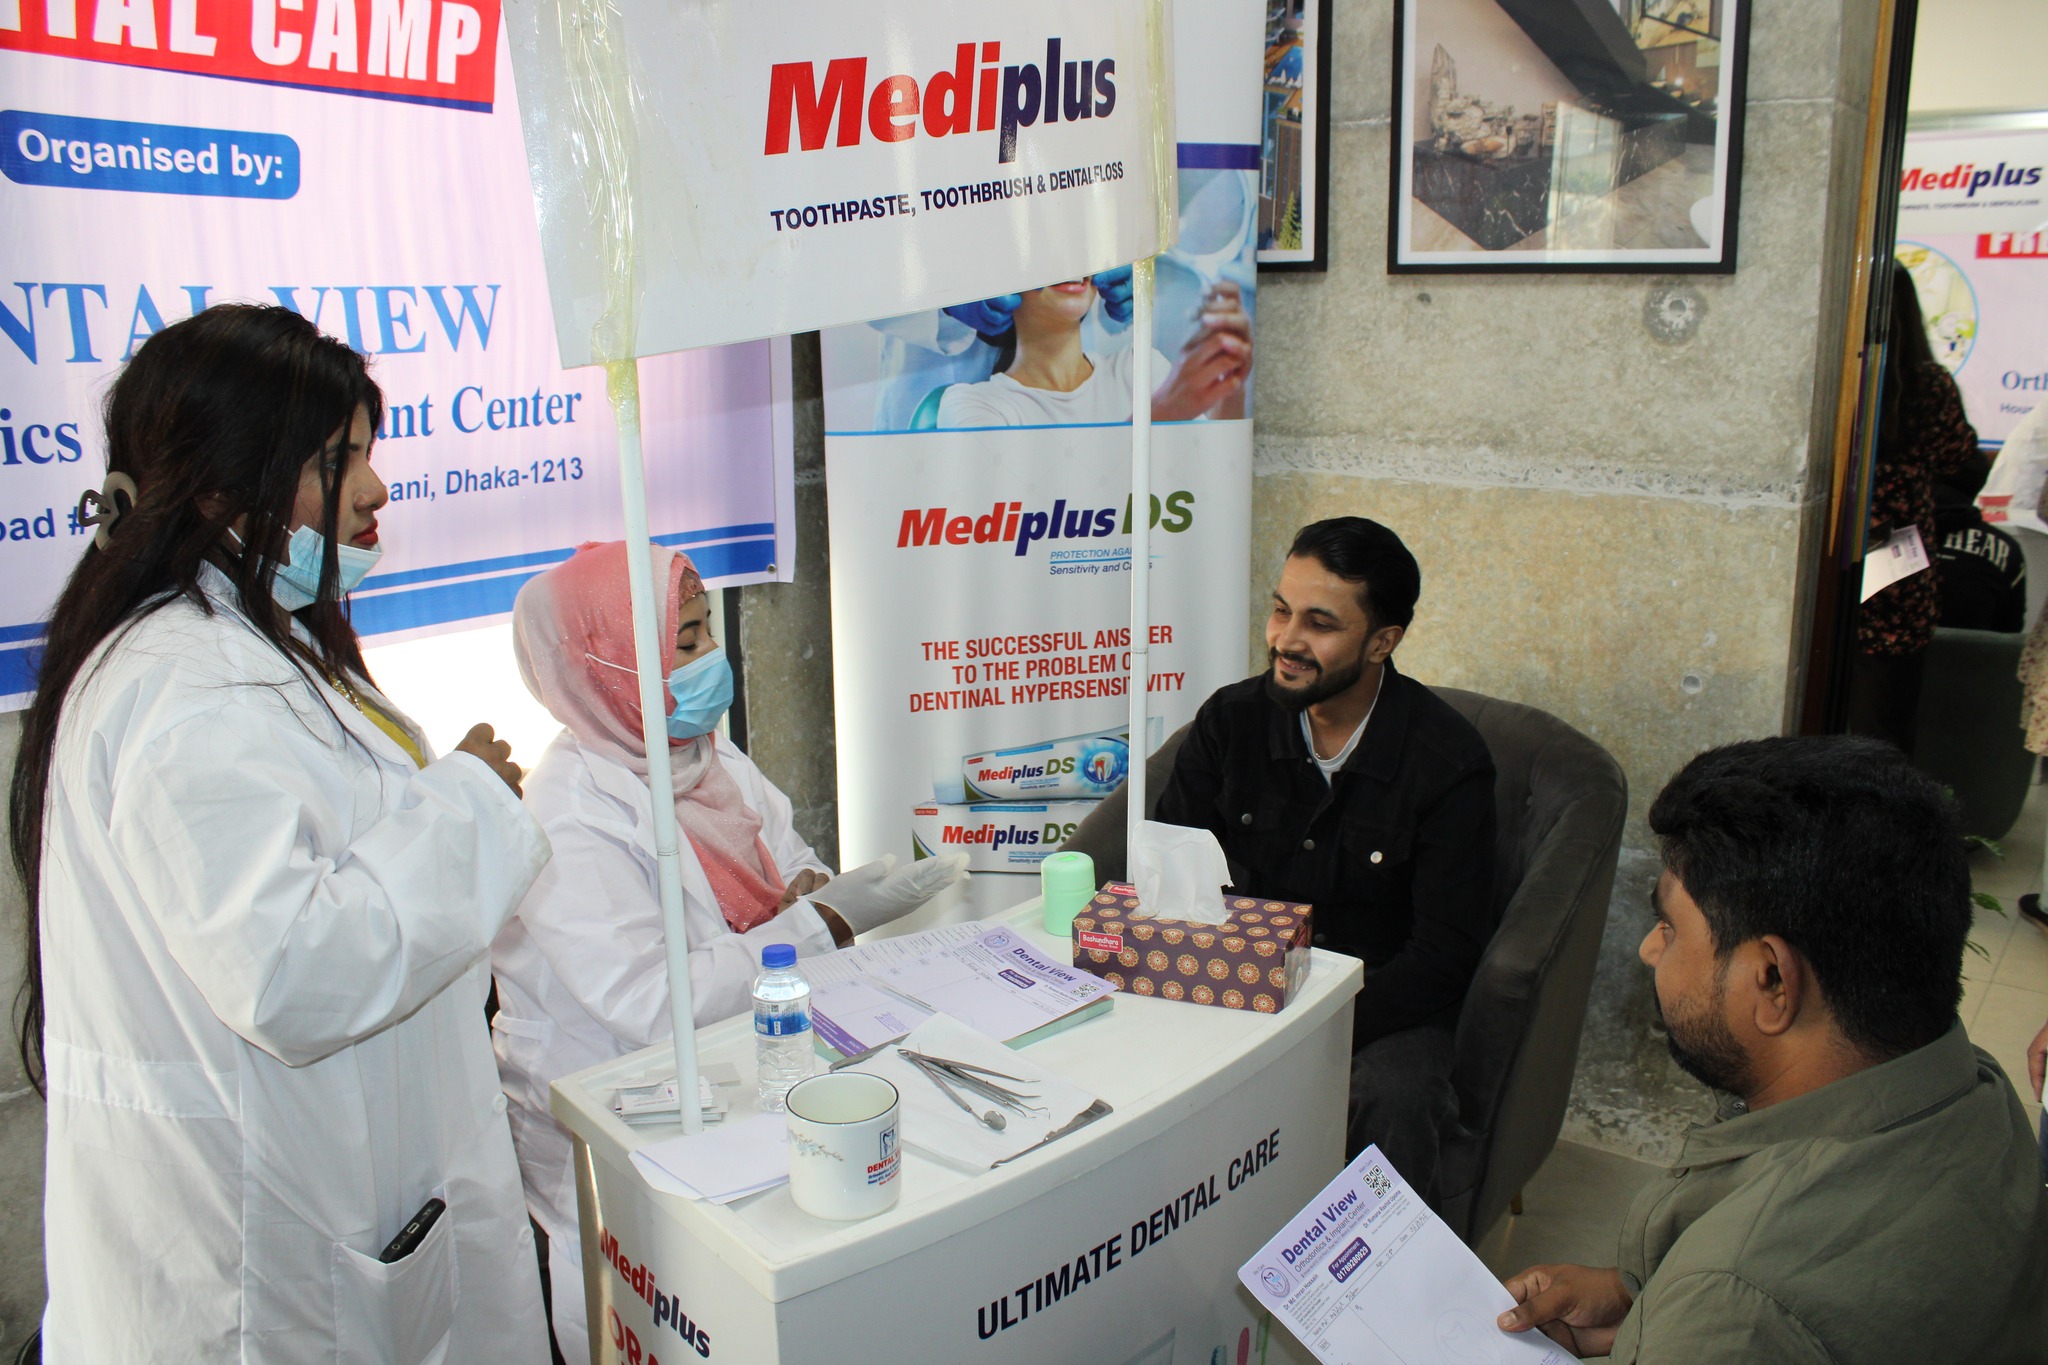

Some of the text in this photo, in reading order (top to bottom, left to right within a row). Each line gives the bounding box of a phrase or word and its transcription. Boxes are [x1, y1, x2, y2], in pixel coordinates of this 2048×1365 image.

[250, 0, 482, 85] CAMP
[764, 37, 1116, 164] Mediplus
[17, 129, 284, 187] Organised by:
[770, 193, 916, 232] TOOTHPASTE,
[920, 176, 1034, 211] TOOTHBRUSH
[1037, 174, 1046, 194] &
[452, 386, 582, 433] Center
[383, 474, 436, 502] ani,
[446, 457, 584, 495] Dhaka-1213
[897, 498, 1117, 557] Mediplus
[1050, 549, 1110, 560] PROTECTION
[1050, 563, 1100, 576] Sensitivity
[1102, 561, 1120, 573] and
[922, 625, 1173, 661] THE SUCCESSFUL ANSER
[952, 665, 977, 684] TO
[983, 661, 1020, 682] THE
[1026, 654, 1116, 679] PROBLEM
[910, 671, 1185, 713] DENTINAL HYPERSENSIVITY
[978, 756, 1076, 784] Mediplus DS
[942, 824, 1039, 850] Mediplus
[1082, 934, 1119, 946] Bashundhara
[1013, 948, 1050, 971] Dental
[1049, 967, 1077, 982] View
[867, 1155, 894, 1173] DENTAL
[977, 1234, 1122, 1341] ULTIMATE
[1130, 1175, 1222, 1257] DENTAL
[1227, 1128, 1280, 1192] CARE
[1281, 1218, 1327, 1265] Dental
[1322, 1189, 1358, 1222] View
[1294, 1242, 1326, 1273] Orthodontics
[1330, 1221, 1348, 1238] Implant
[1347, 1202, 1365, 1220] Center
[1332, 1262, 1340, 1271] For
[600, 1226, 710, 1359] Mediplus
[607, 1304, 661, 1365] OR
